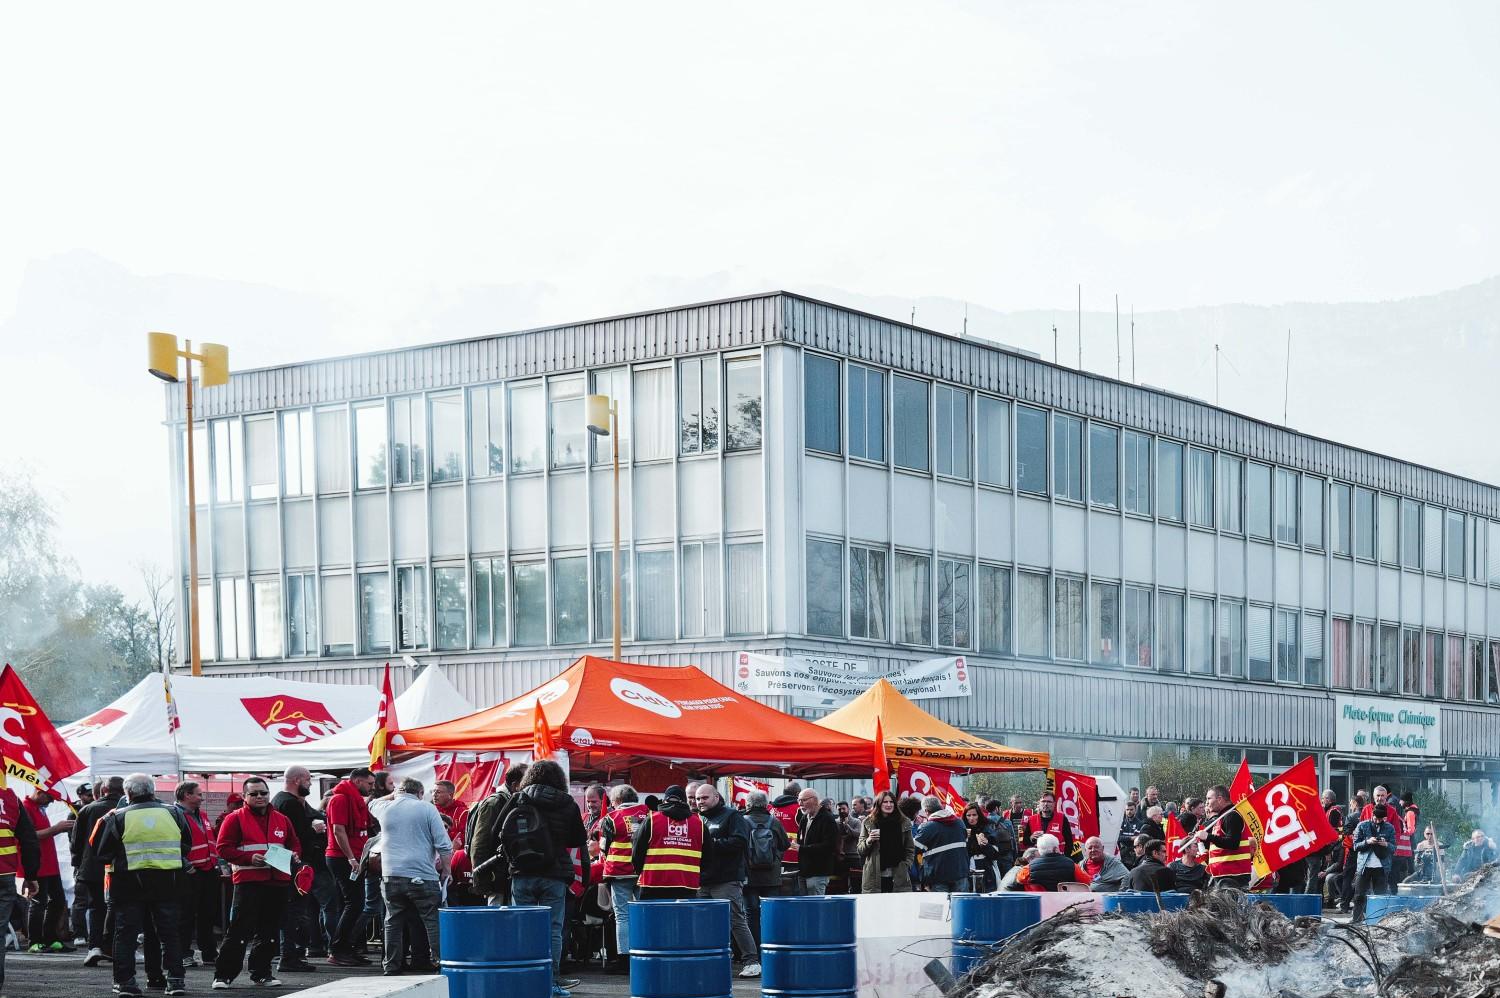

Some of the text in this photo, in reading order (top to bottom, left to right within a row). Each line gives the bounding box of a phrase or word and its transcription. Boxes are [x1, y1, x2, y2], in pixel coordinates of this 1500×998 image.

[755, 668, 791, 677] Sauvons
[794, 671, 810, 680] nos
[767, 680, 815, 691] Préservons
[262, 700, 323, 725] la
[1343, 704, 1436, 727] Plate-forme Chimique
[1353, 729, 1428, 749] du Pont-de-Claix
[919, 748, 951, 759] Years
[956, 752, 966, 760] in
[969, 752, 1040, 764] Motorsports
[669, 822, 688, 835] cgt
[1264, 784, 1318, 861] cgt
